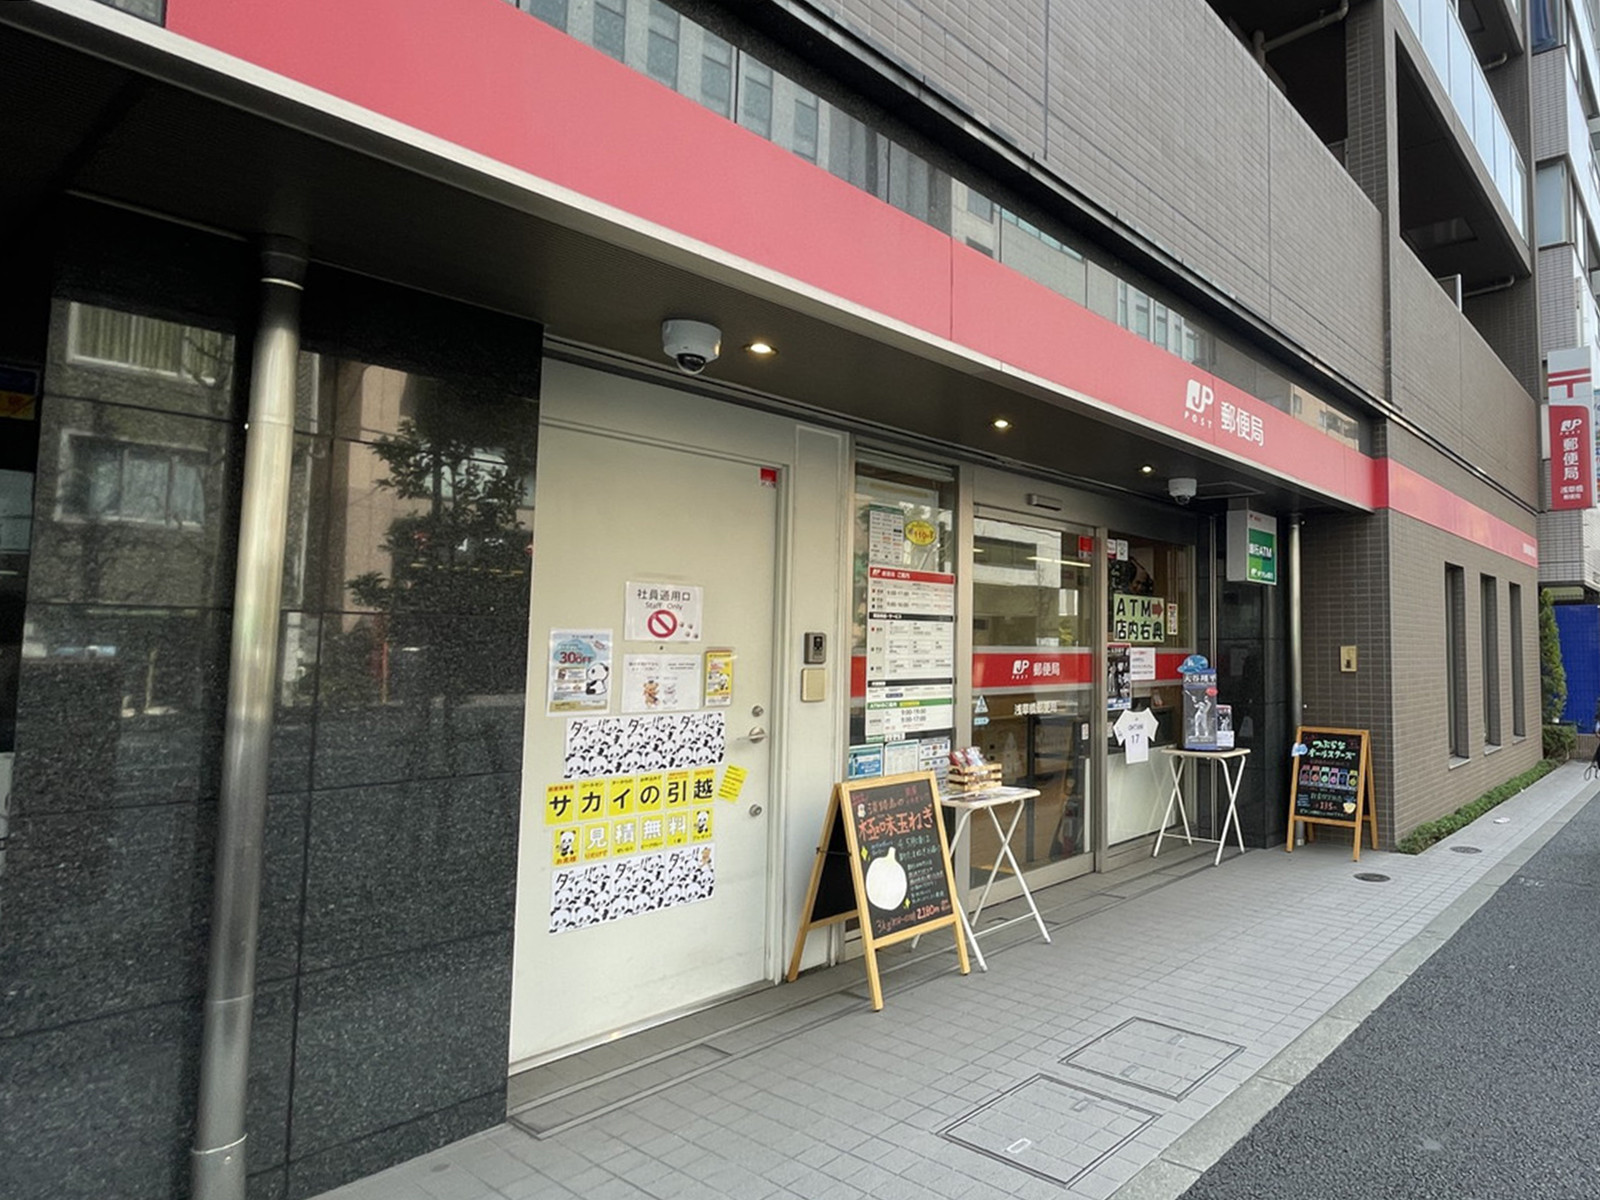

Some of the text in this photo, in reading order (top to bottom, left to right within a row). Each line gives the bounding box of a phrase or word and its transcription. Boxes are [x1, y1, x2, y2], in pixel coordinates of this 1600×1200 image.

[1184, 411, 1212, 429] POST
[1220, 401, 1264, 447] 郵便局
[1562, 437, 1580, 481] 郵便局
[637, 588, 691, 601] 社員通用口
[1116, 598, 1151, 617] ATM
[1033, 662, 1060, 676] 郵便局
[1131, 734, 1140, 744] 17
[549, 778, 714, 817] サカイの引越
[586, 815, 688, 850] 見積無料
